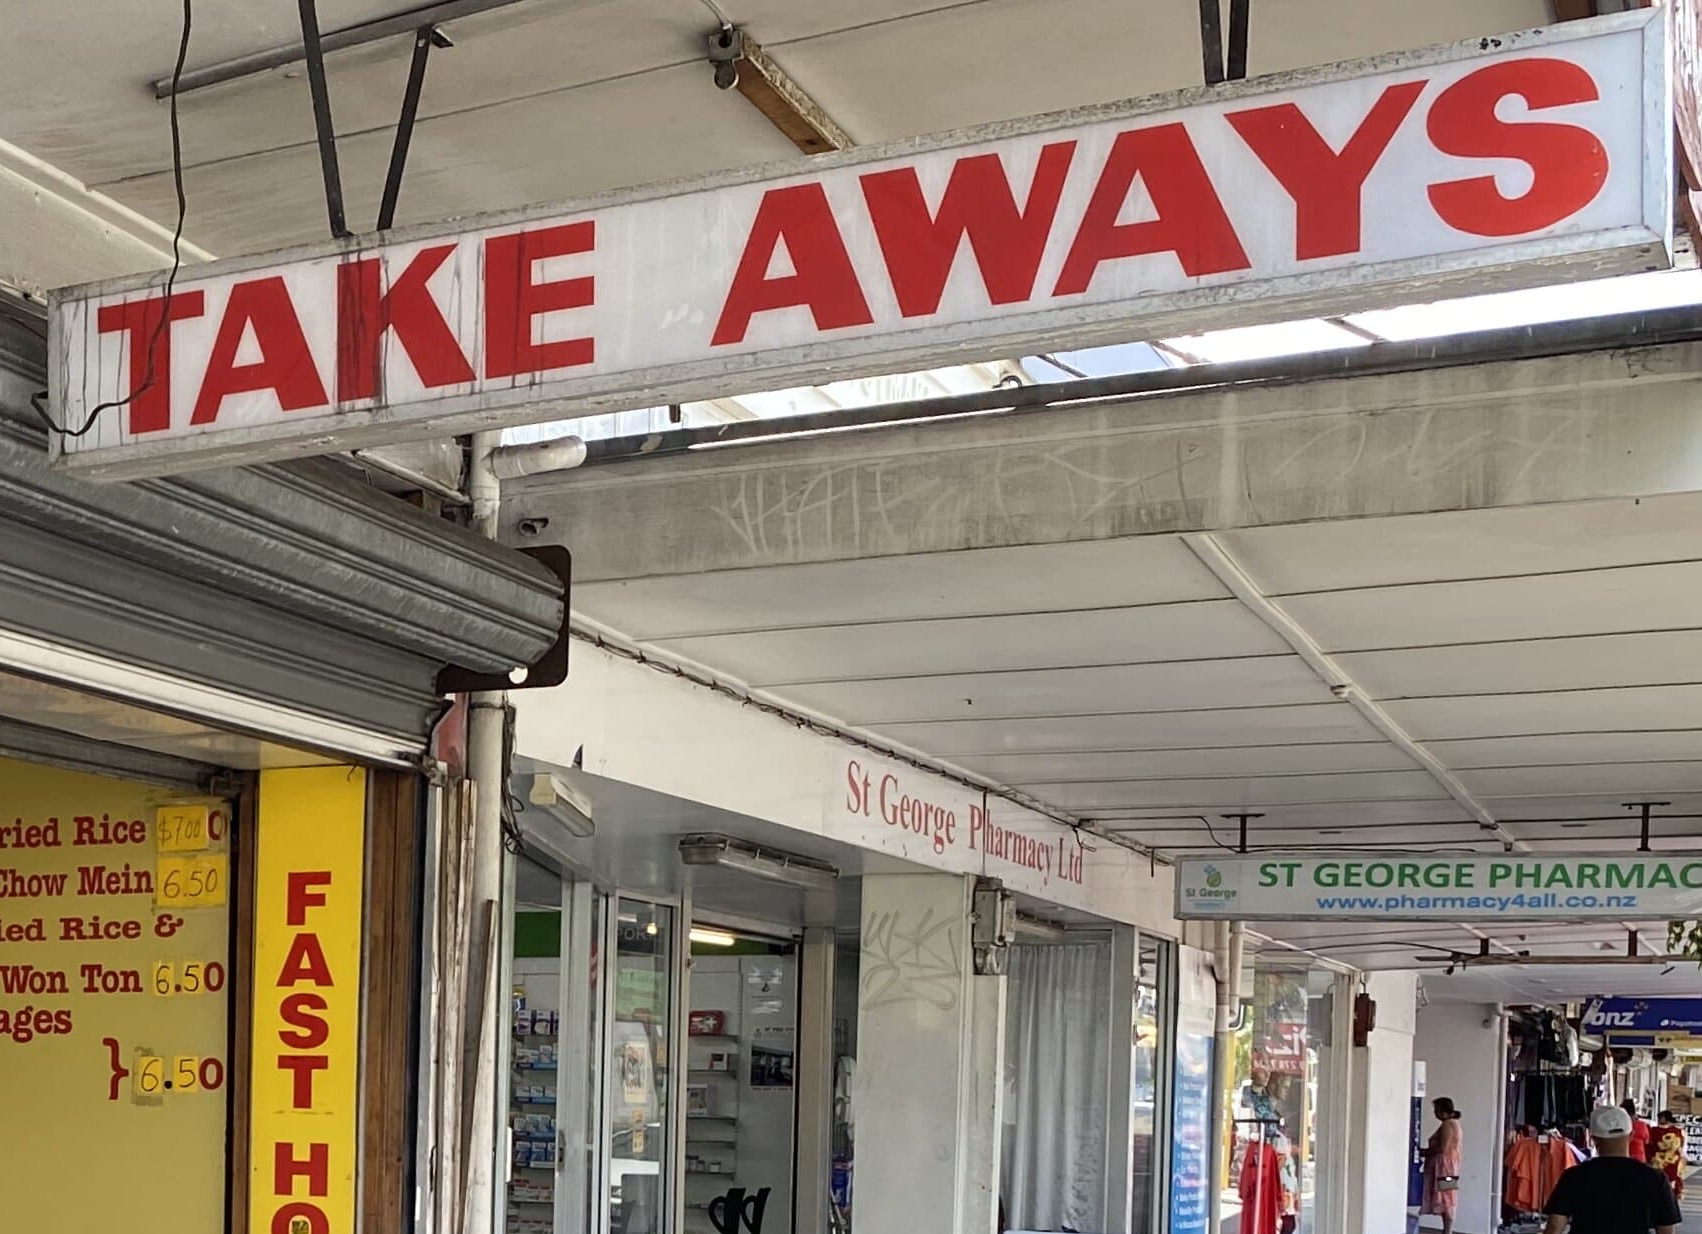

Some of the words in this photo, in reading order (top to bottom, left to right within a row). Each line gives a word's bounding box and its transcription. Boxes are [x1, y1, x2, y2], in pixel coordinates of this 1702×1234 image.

[96, 218, 597, 434] TAKE
[709, 56, 1611, 346] AWAYS
[73, 814, 146, 845] Rice
[847, 760, 871, 817] St
[879, 774, 956, 854] George
[968, 804, 1054, 886] Pharmacy
[1058, 837, 1083, 884] Ltd
[77, 864, 154, 896] Mein
[162, 868, 219, 900] 6.50
[1258, 862, 1301, 888] ST
[1313, 862, 1475, 889] GEORGE
[1200, 888, 1237, 900] George
[1316, 892, 1637, 911] www.pharmacy4all.co.nz
[59, 916, 141, 941] Rice
[154, 914, 185, 938] &
[80, 964, 143, 993] Ton
[154, 961, 225, 996] 6.50
[276, 871, 334, 1110] FAST
